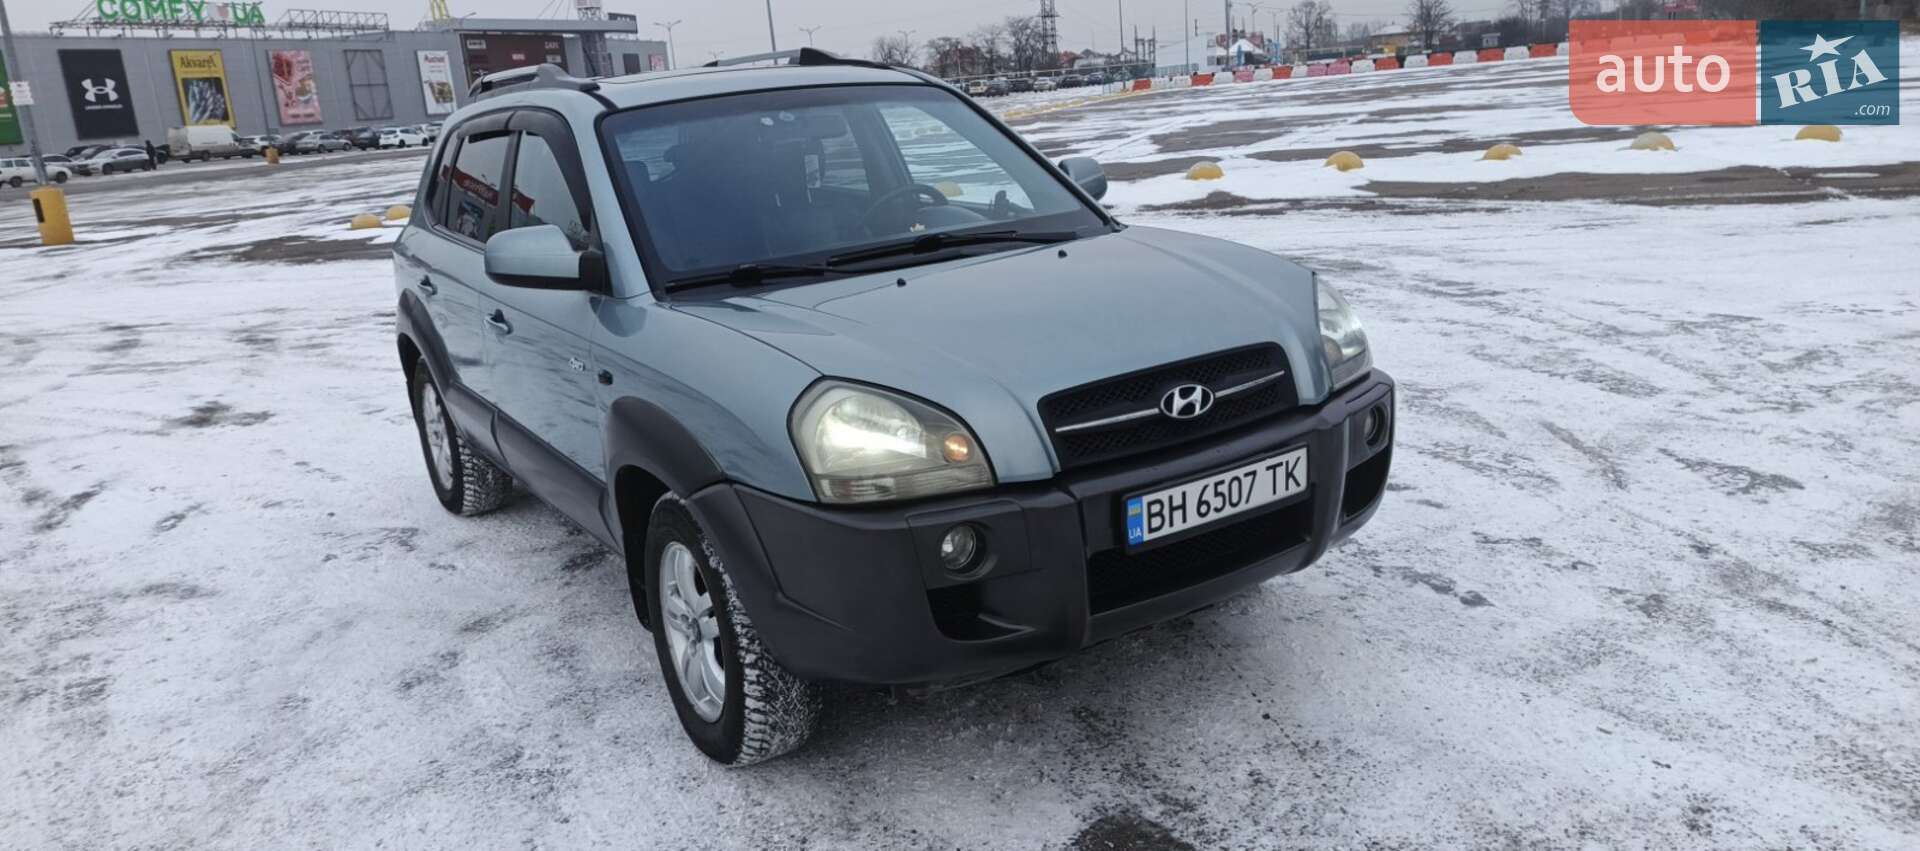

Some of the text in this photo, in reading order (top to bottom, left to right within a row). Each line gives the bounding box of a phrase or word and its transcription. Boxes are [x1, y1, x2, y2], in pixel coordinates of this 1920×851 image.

[97, 0, 266, 24] COMFY UA
[1147, 455, 1302, 534] BH 6507 TK
[1128, 528, 1143, 540] UA
